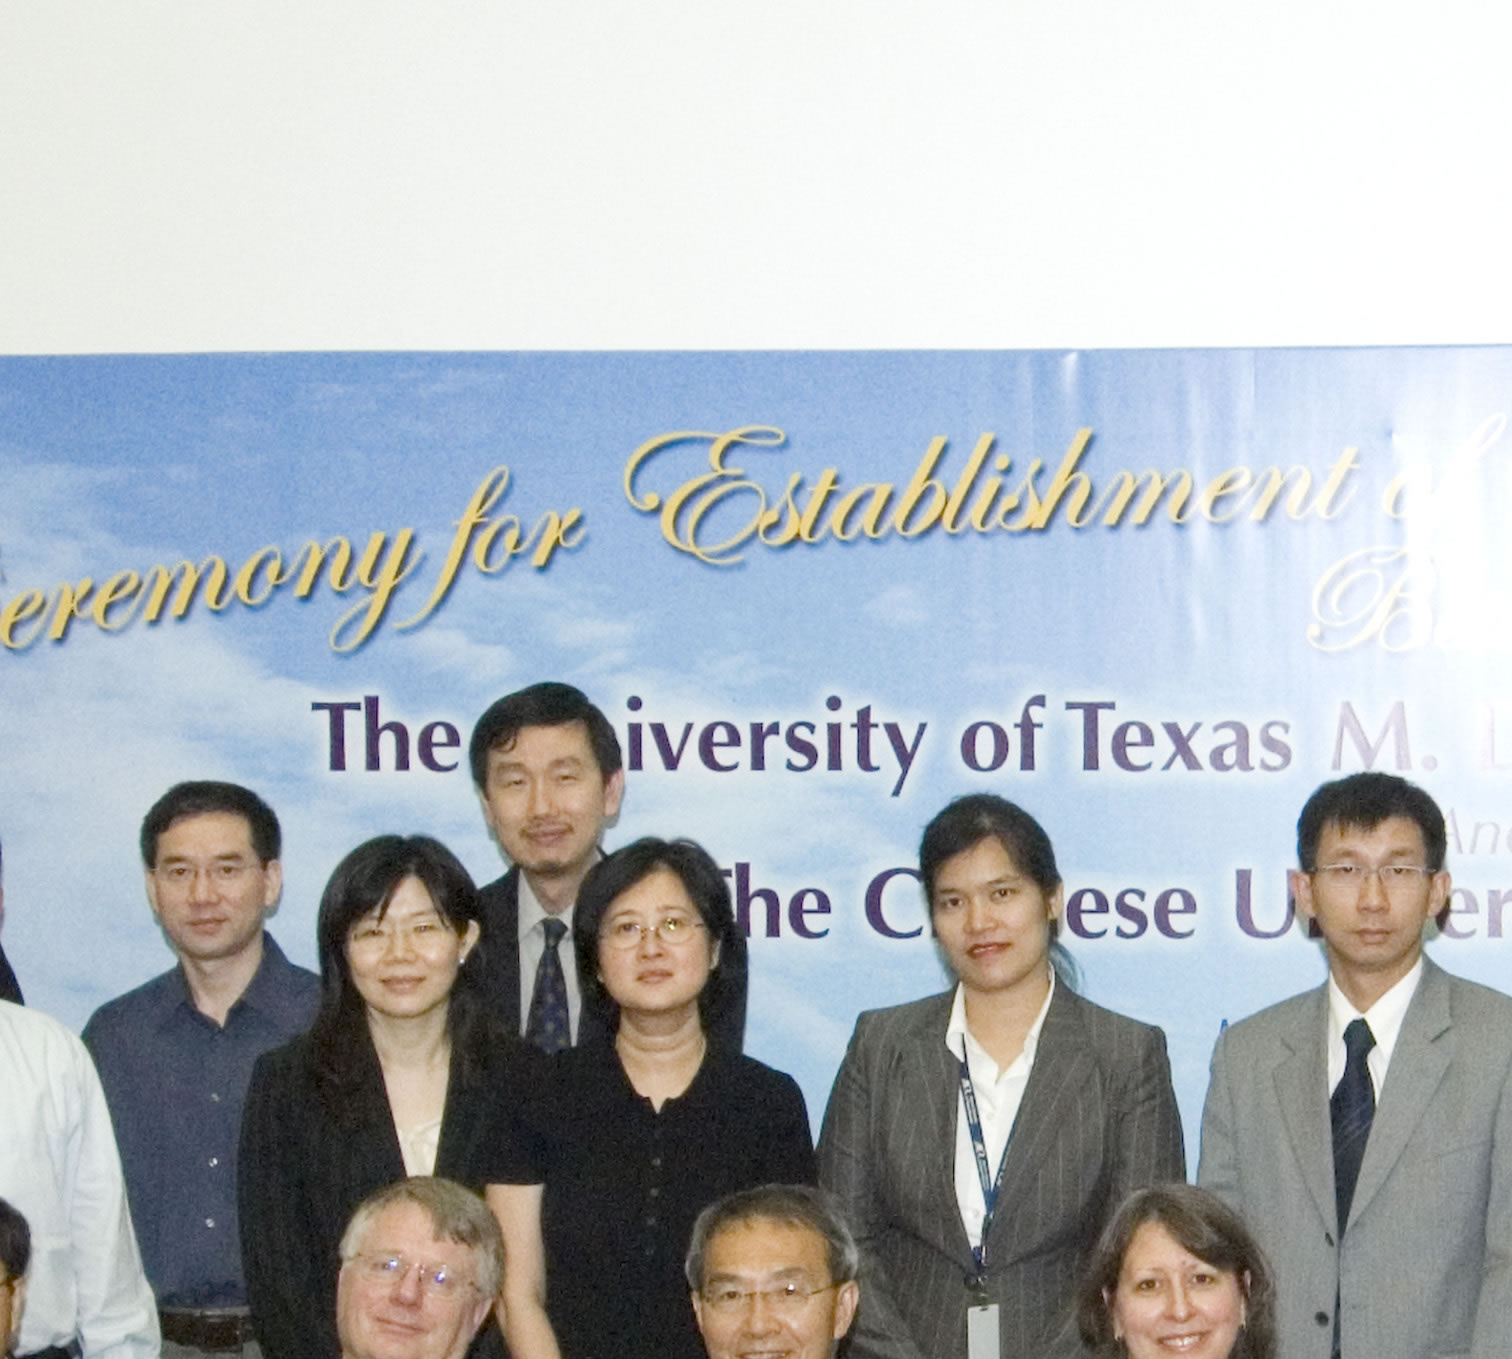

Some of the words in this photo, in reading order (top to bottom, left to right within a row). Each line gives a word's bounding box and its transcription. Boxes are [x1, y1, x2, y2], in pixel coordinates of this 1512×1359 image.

[392, 465, 584, 630] for
[623, 424, 1357, 566] Establishment
[312, 696, 460, 772] The
[627, 696, 928, 797] iversity
[960, 695, 1046, 771] of
[1065, 700, 1292, 771] Texas
[1332, 700, 1438, 770] M.
[719, 862, 831, 939] he
[865, 866, 1197, 940] Cese
